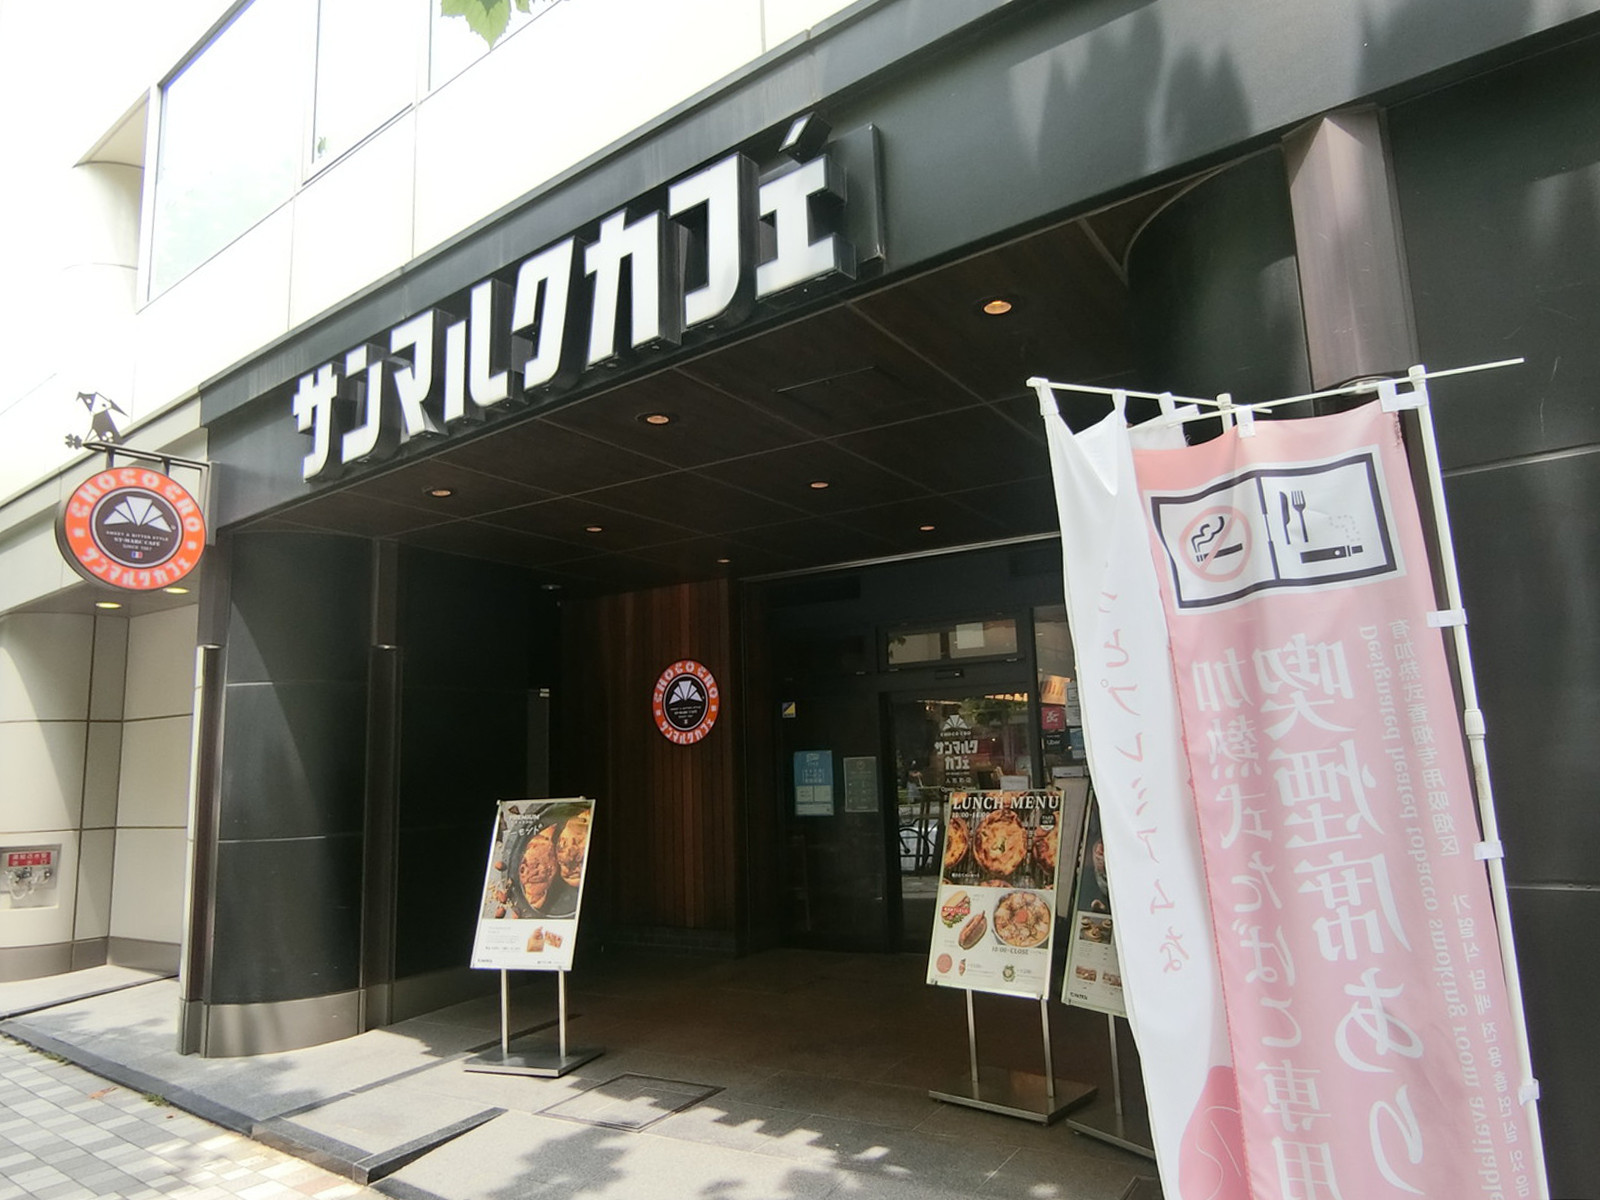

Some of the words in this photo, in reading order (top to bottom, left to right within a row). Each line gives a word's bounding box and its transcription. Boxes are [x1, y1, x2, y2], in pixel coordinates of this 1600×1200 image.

[293, 114, 838, 479] サンマルクカフェ
[71, 470, 160, 518] CHOCO
[165, 486, 201, 532] CRO
[82, 547, 191, 586] サンマルクカフェ
[654, 661, 694, 703] CHOCO
[697, 665, 718, 699] CRO
[934, 740, 978, 755] サンマルク
[944, 755, 970, 770] カフェ
[953, 796, 1003, 810] LUNCH
[1010, 795, 1060, 810] MENU
